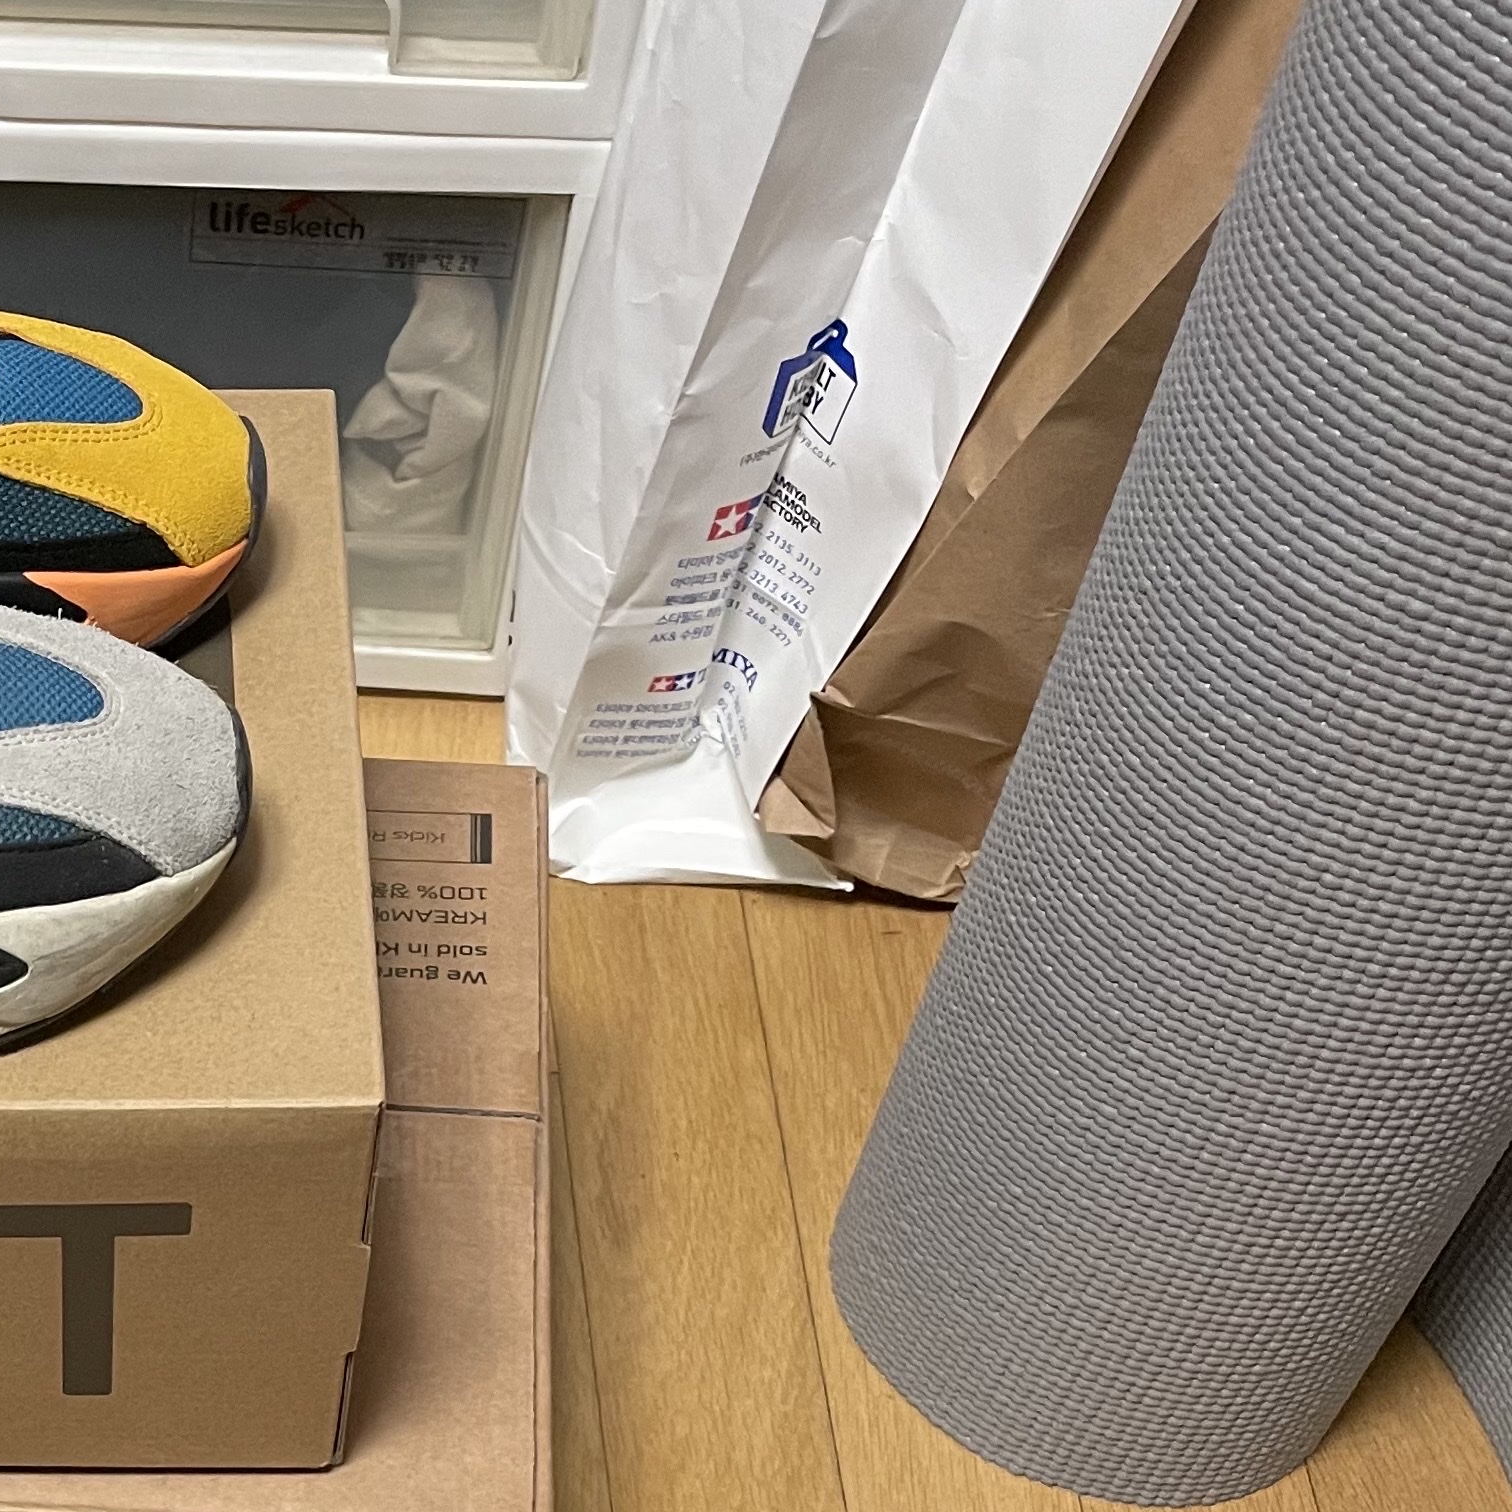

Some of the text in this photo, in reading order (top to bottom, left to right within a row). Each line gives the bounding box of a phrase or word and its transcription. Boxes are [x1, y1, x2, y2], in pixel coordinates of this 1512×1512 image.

[762, 495, 809, 533] ACTORY
[767, 487, 822, 534] LAMODEL
[392, 830, 446, 844] Kicks
[417, 885, 488, 901] 100%
[408, 942, 428, 958] in
[437, 943, 488, 958] sold
[378, 965, 488, 985] We guar
